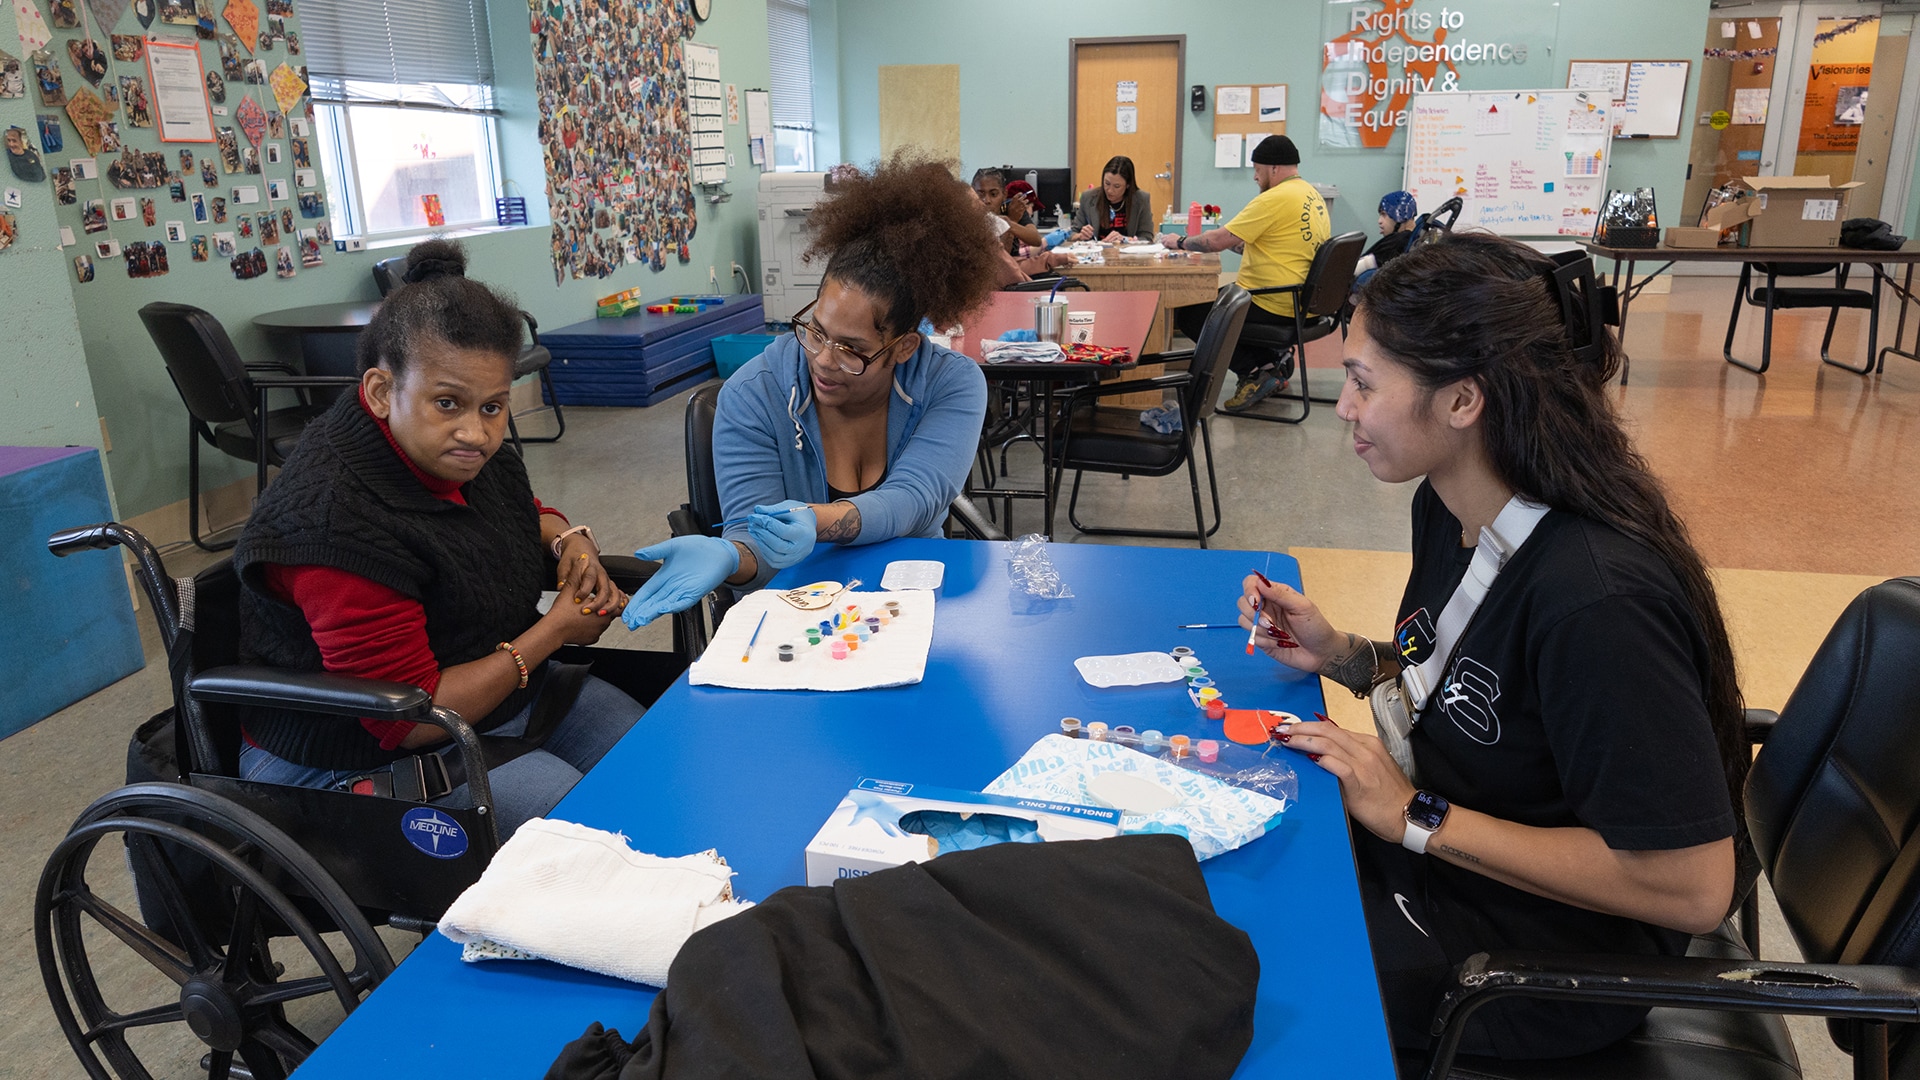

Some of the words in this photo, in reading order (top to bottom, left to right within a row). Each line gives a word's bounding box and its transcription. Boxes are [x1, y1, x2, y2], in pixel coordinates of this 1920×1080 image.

[1350, 7, 1432, 37] Rights
[1440, 6, 1465, 30] to
[1348, 38, 1528, 68] Independence
[1811, 65, 1870, 80] Visionaries
[1346, 71, 1435, 101] Dignity
[1440, 70, 1460, 93] &
[1017, 800, 1047, 809] ONLY
[1047, 804, 1071, 812] USE
[1072, 807, 1114, 819] SINGLE
[409, 820, 459, 838] MEDLINE
[861, 847, 885, 855] POWDER
